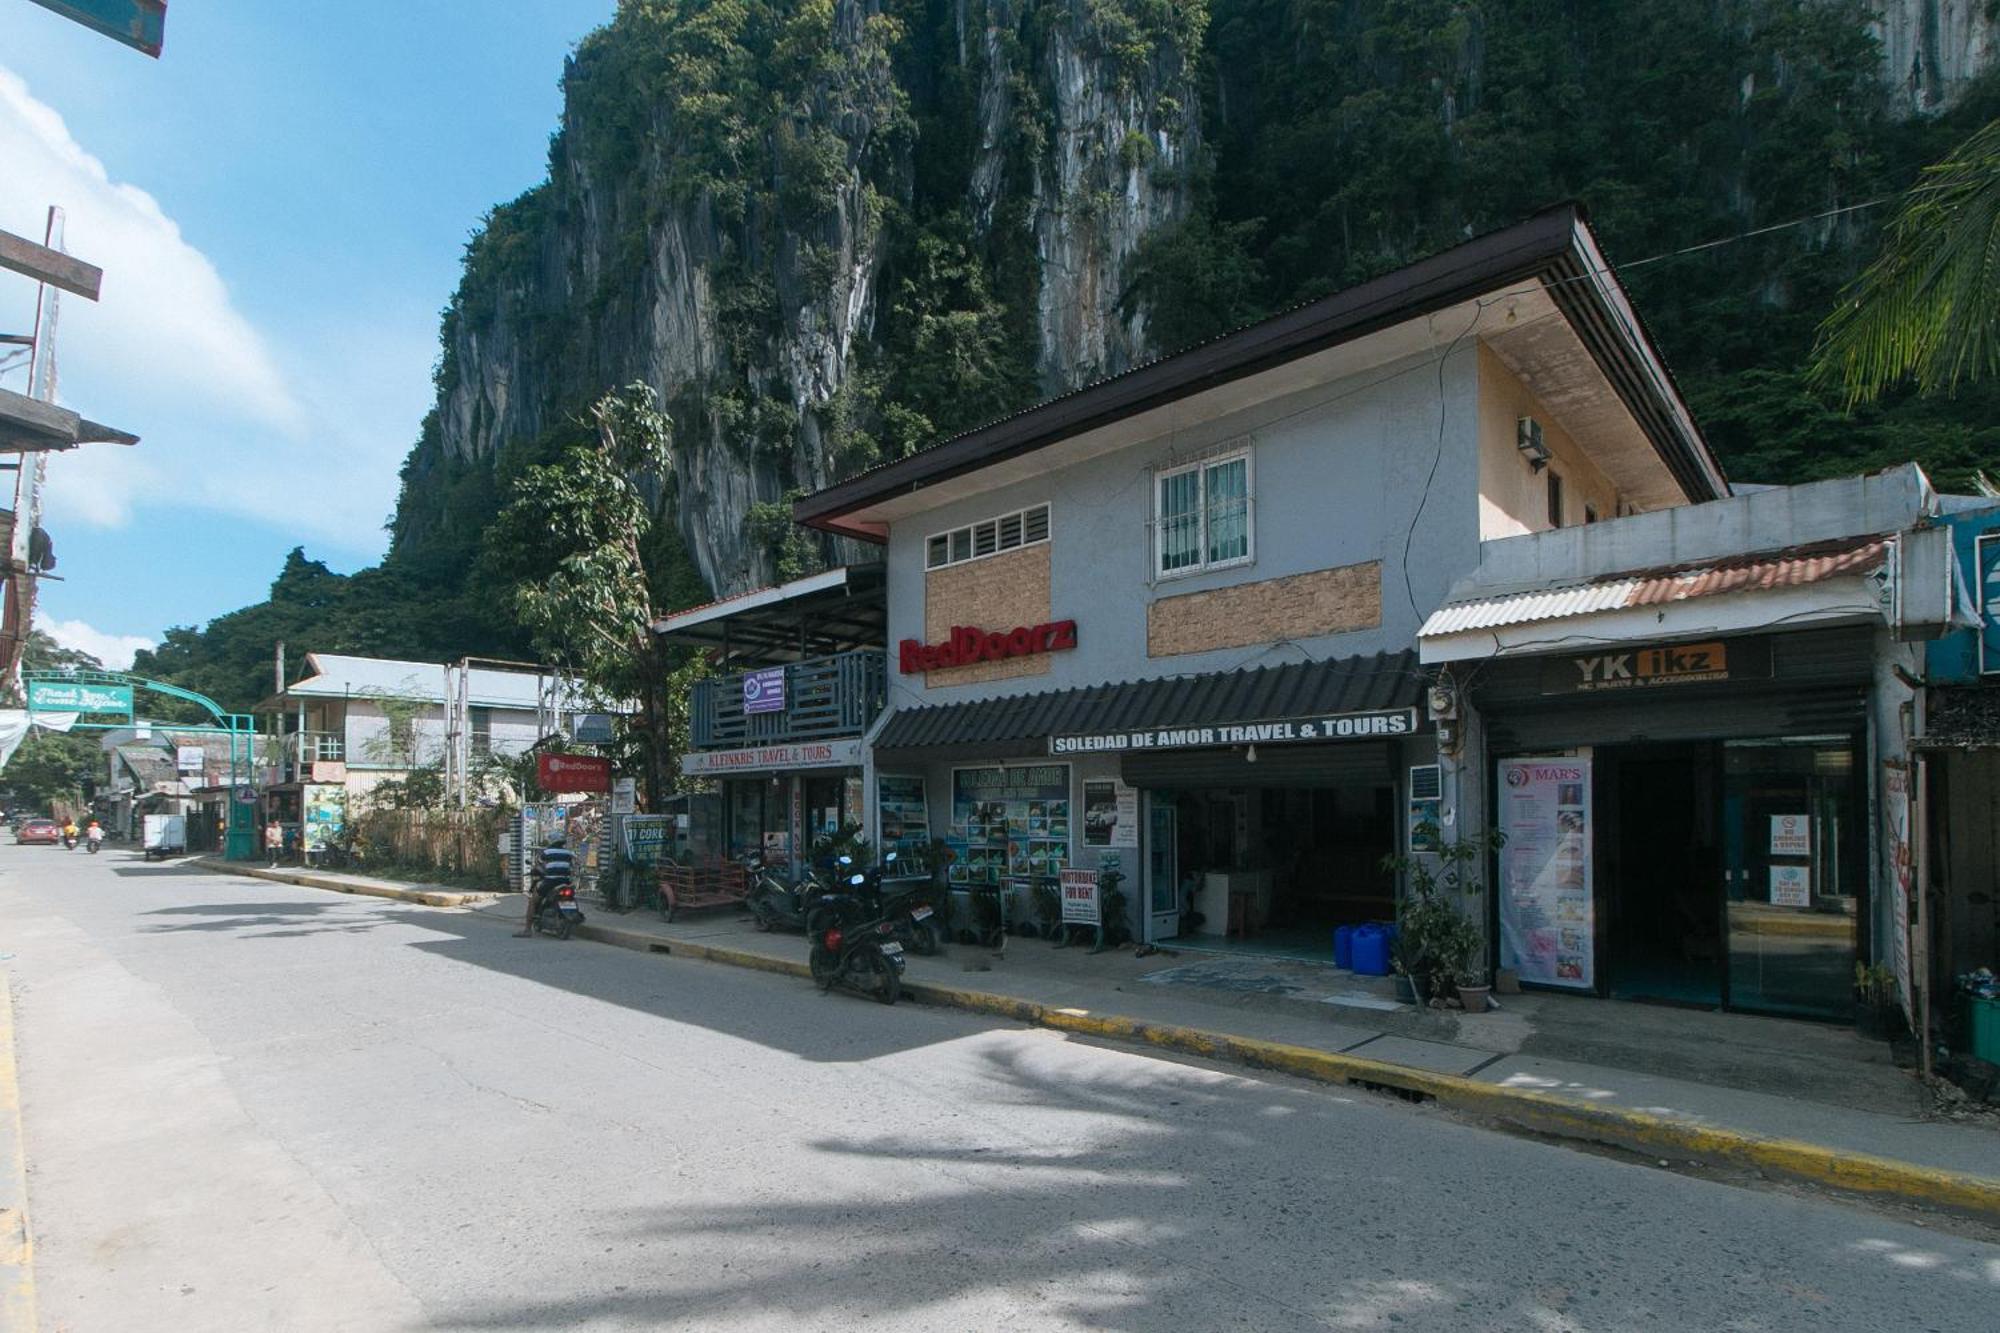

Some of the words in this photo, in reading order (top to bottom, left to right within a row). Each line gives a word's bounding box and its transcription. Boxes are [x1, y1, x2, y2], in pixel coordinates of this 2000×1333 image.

[899, 619, 1077, 674] RedDoorz
[1574, 654, 1632, 682] YK
[1055, 734, 1128, 751] SOLEDAD
[1131, 732, 1154, 748] DE
[1156, 728, 1214, 747] AMOR
[1218, 723, 1295, 742] TRAVEL
[1300, 723, 1317, 738] &
[1322, 715, 1406, 737] TOURS
[758, 747, 792, 763] TRAVEL
[803, 744, 833, 761] TOURS
[1535, 768, 1581, 781] MAR'S
[1065, 886, 1076, 899] FOR
[1078, 886, 1093, 900] RENT
